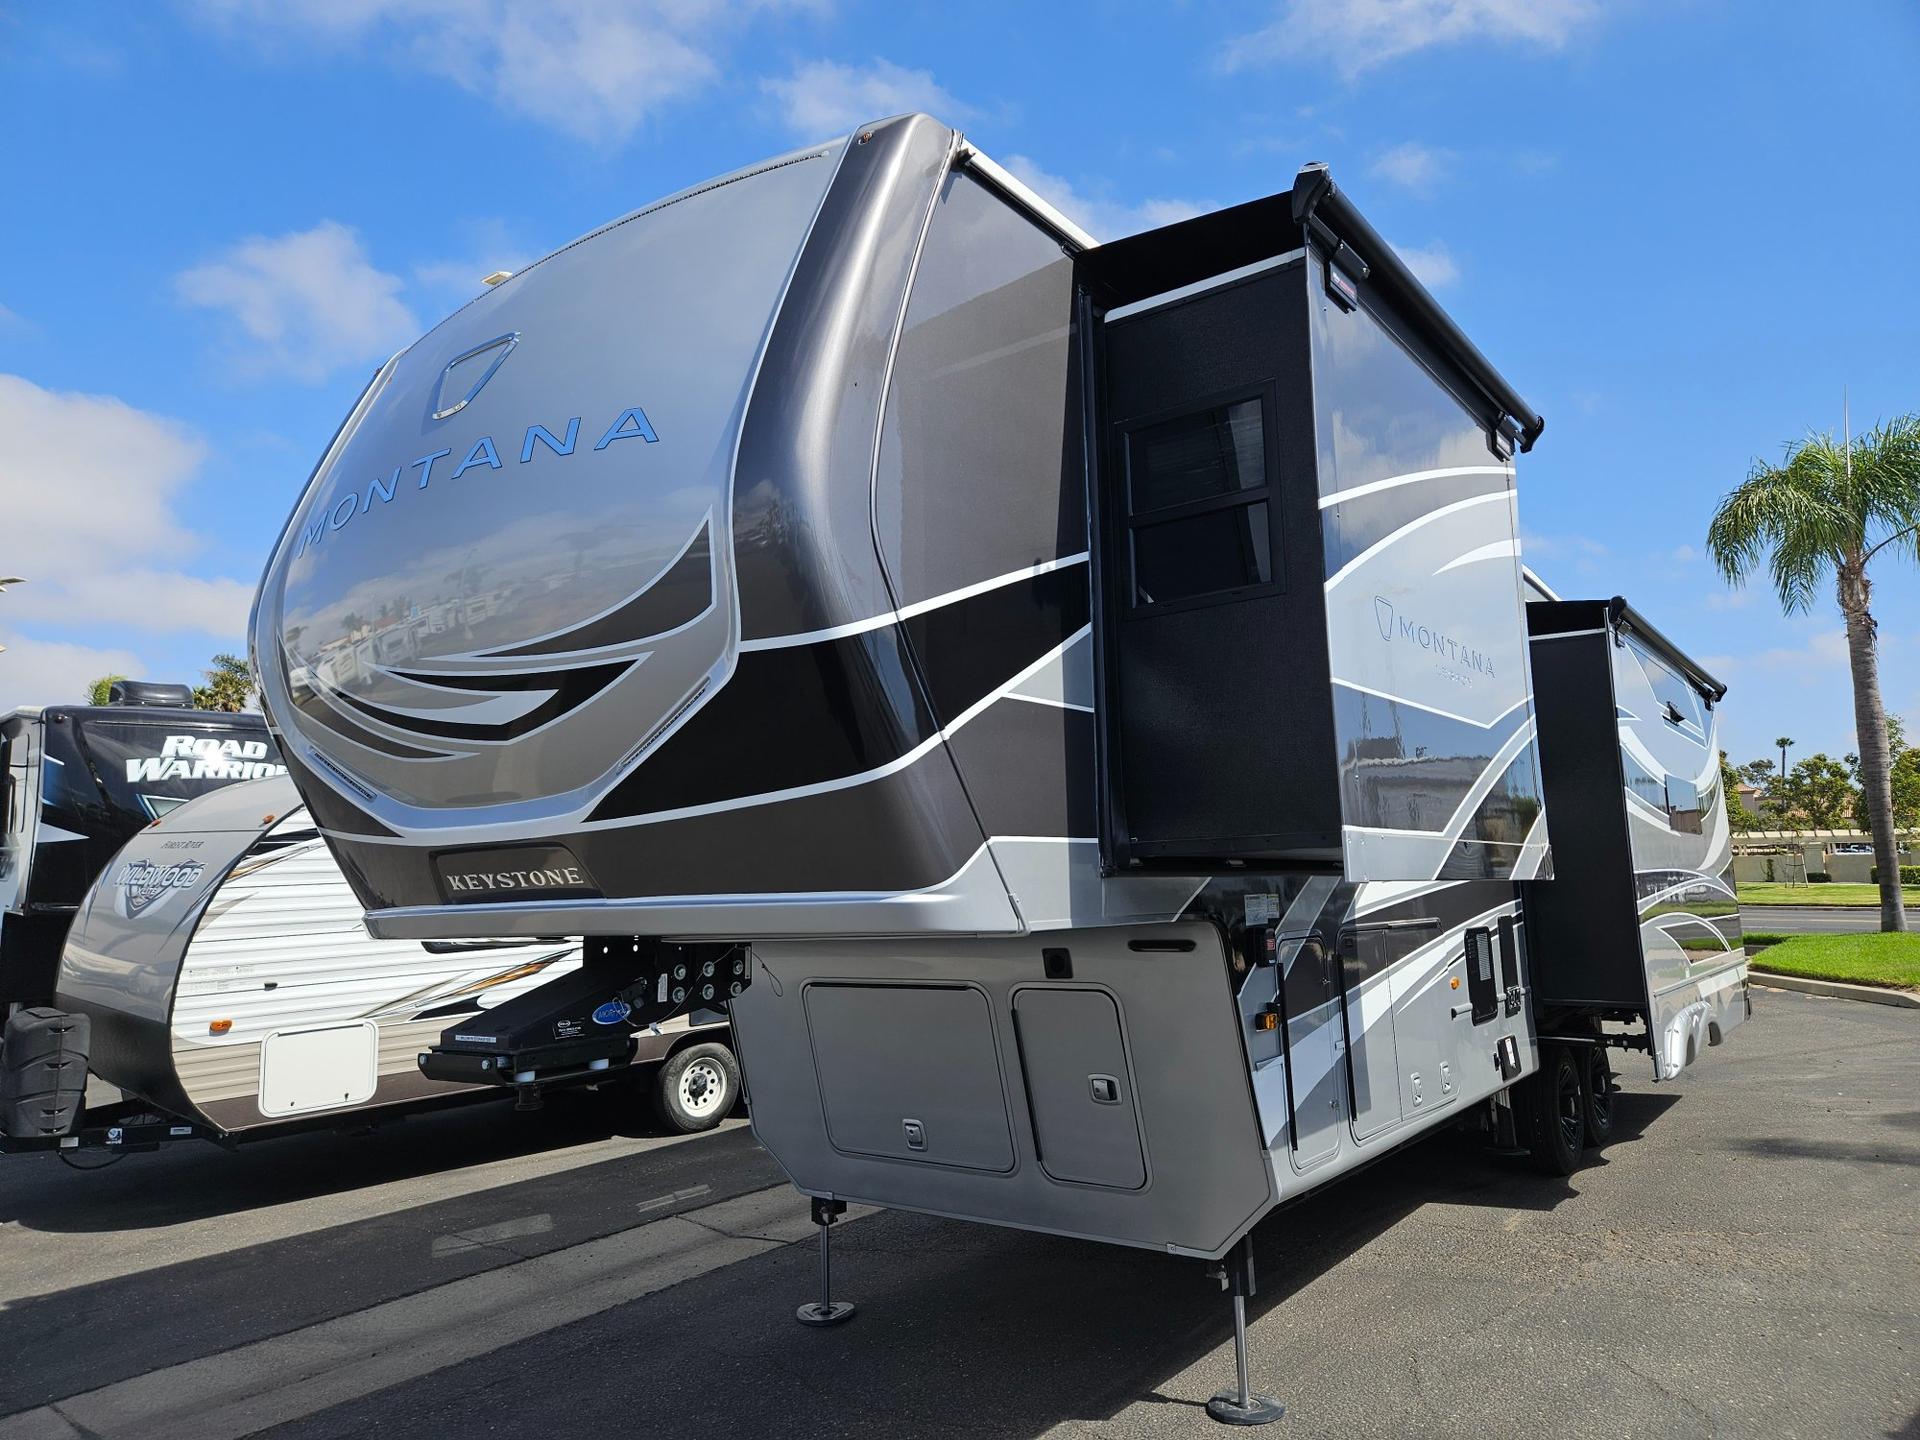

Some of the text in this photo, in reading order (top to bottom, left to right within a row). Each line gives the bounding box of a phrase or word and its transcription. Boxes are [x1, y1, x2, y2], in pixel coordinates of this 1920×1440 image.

[298, 406, 660, 559] MONTANA
[1399, 615, 1496, 678] MONTANA
[160, 735, 268, 760] ROAD
[116, 865, 204, 888] WILDWOOD
[446, 867, 584, 891] KEYSTONE
